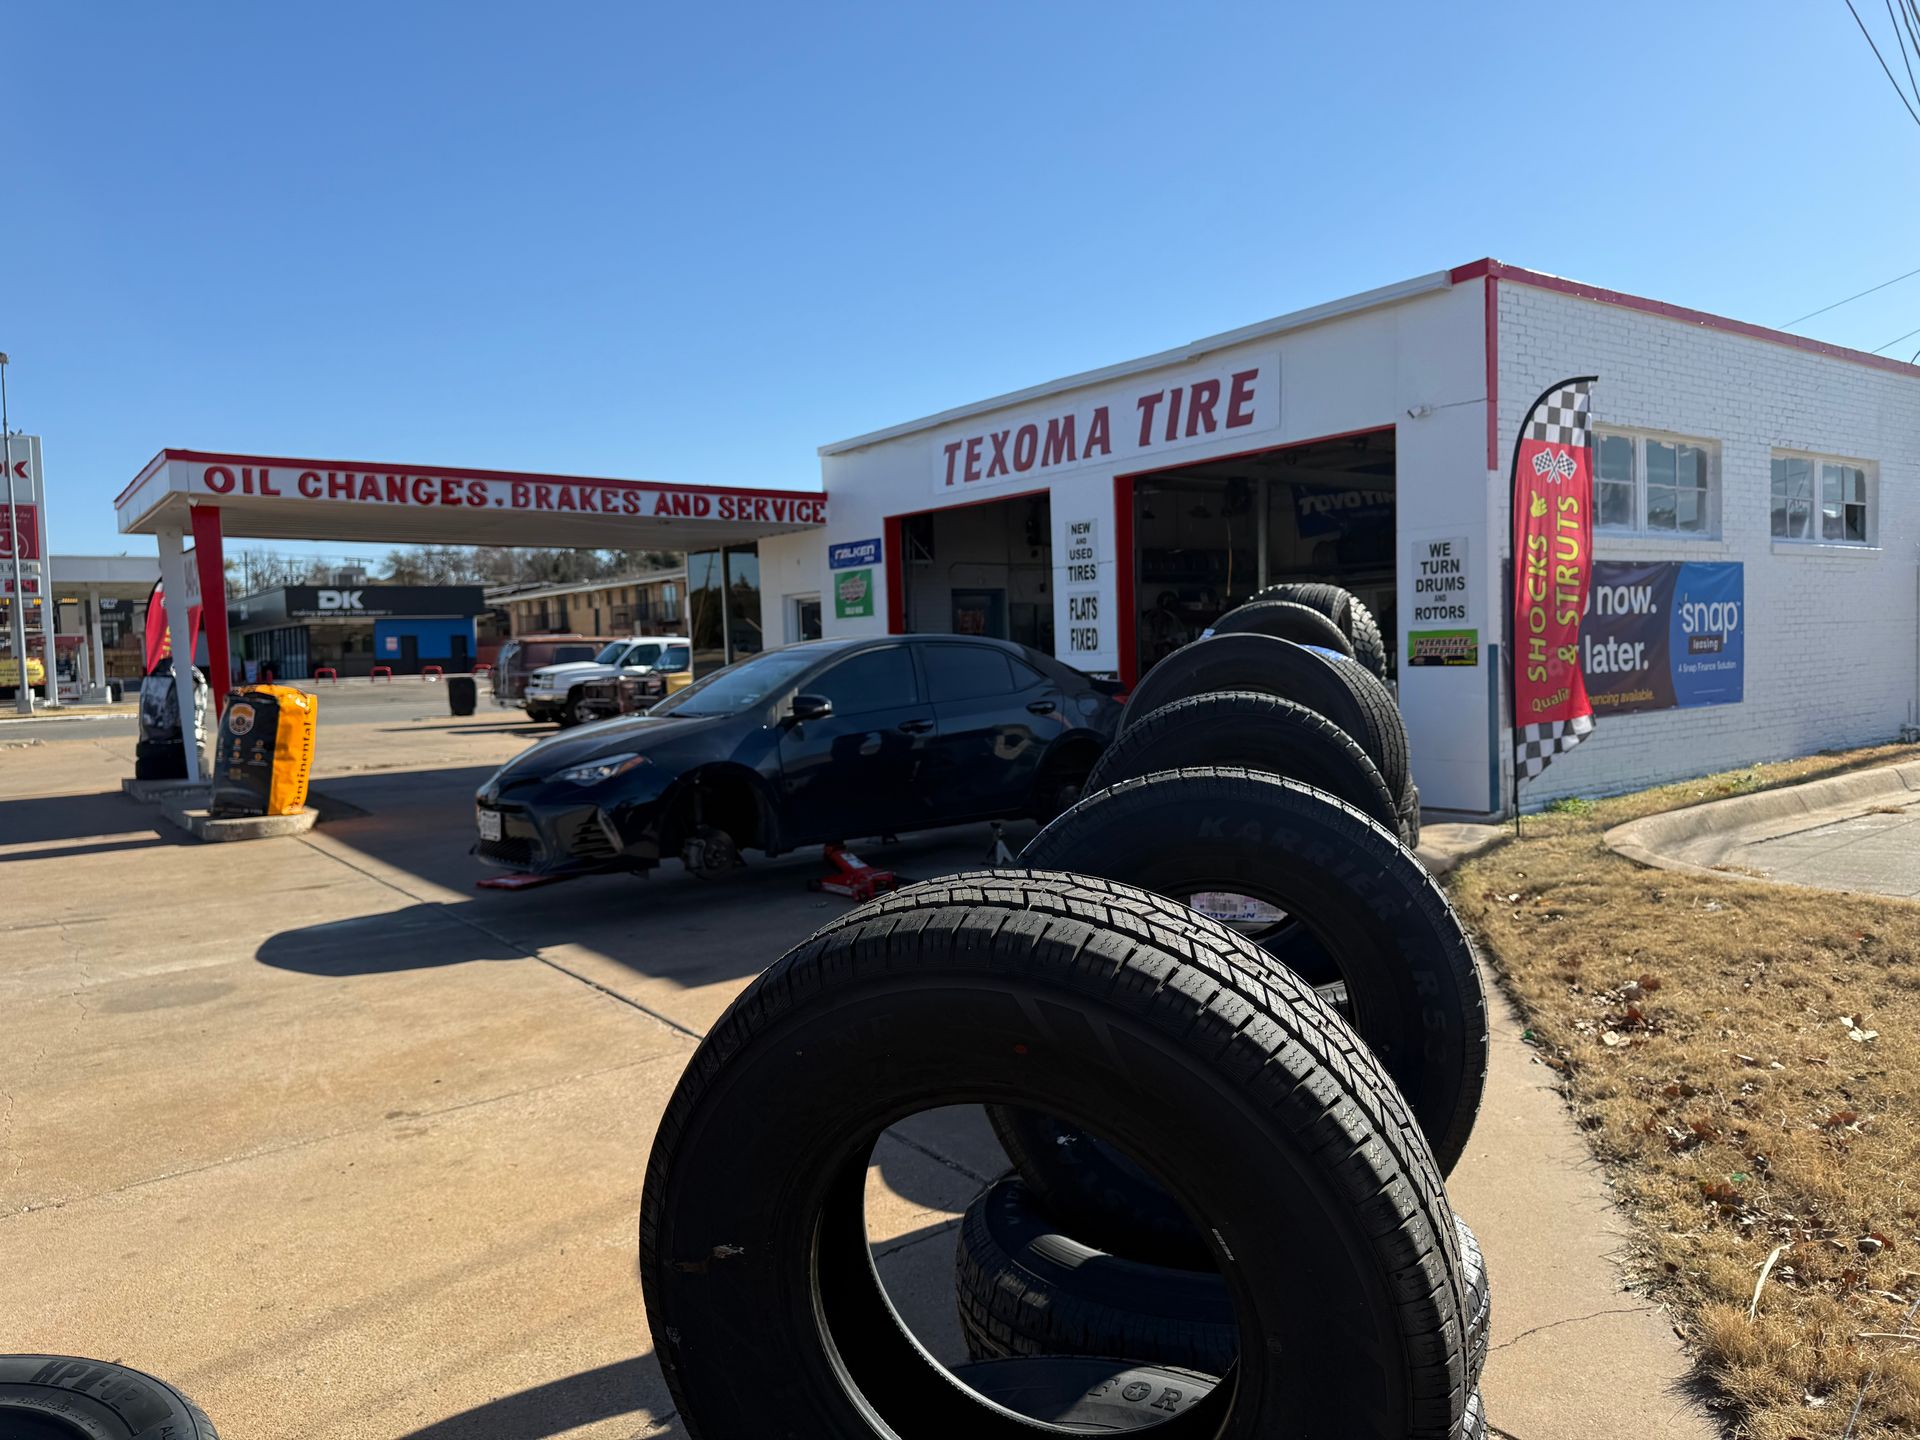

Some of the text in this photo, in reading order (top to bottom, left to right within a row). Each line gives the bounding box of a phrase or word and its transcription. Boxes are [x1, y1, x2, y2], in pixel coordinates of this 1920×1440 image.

[944, 367, 1259, 486] TEXOMA TIRE
[204, 466, 827, 524] OIL CHANGES. BRAKES AND SERVICE
[1071, 522, 1091, 536] NEW
[1076, 537, 1087, 545] AND
[1429, 542, 1451, 558] WE
[835, 544, 875, 560] FALKEN
[1069, 547, 1093, 561] USED
[1068, 564, 1096, 582] TIRES
[1420, 558, 1460, 576] TURN
[1415, 576, 1465, 593] DRUMS
[1555, 495, 1580, 666] & STRUTS
[317, 590, 364, 609] DK
[1434, 594, 1447, 602] AND
[1596, 586, 1658, 616] now.
[1069, 596, 1098, 622] FLATS
[1414, 605, 1466, 621] ROTORS
[1527, 533, 1549, 683] SHOCKS
[1682, 601, 1738, 643] snap
[1070, 627, 1098, 652] FIXED
[1414, 637, 1472, 647] INTERSTATE
[1693, 639, 1719, 651] leasing
[1585, 635, 1649, 674] later.
[1683, 663, 1697, 674] Snap
[1717, 660, 1737, 670] Solution
